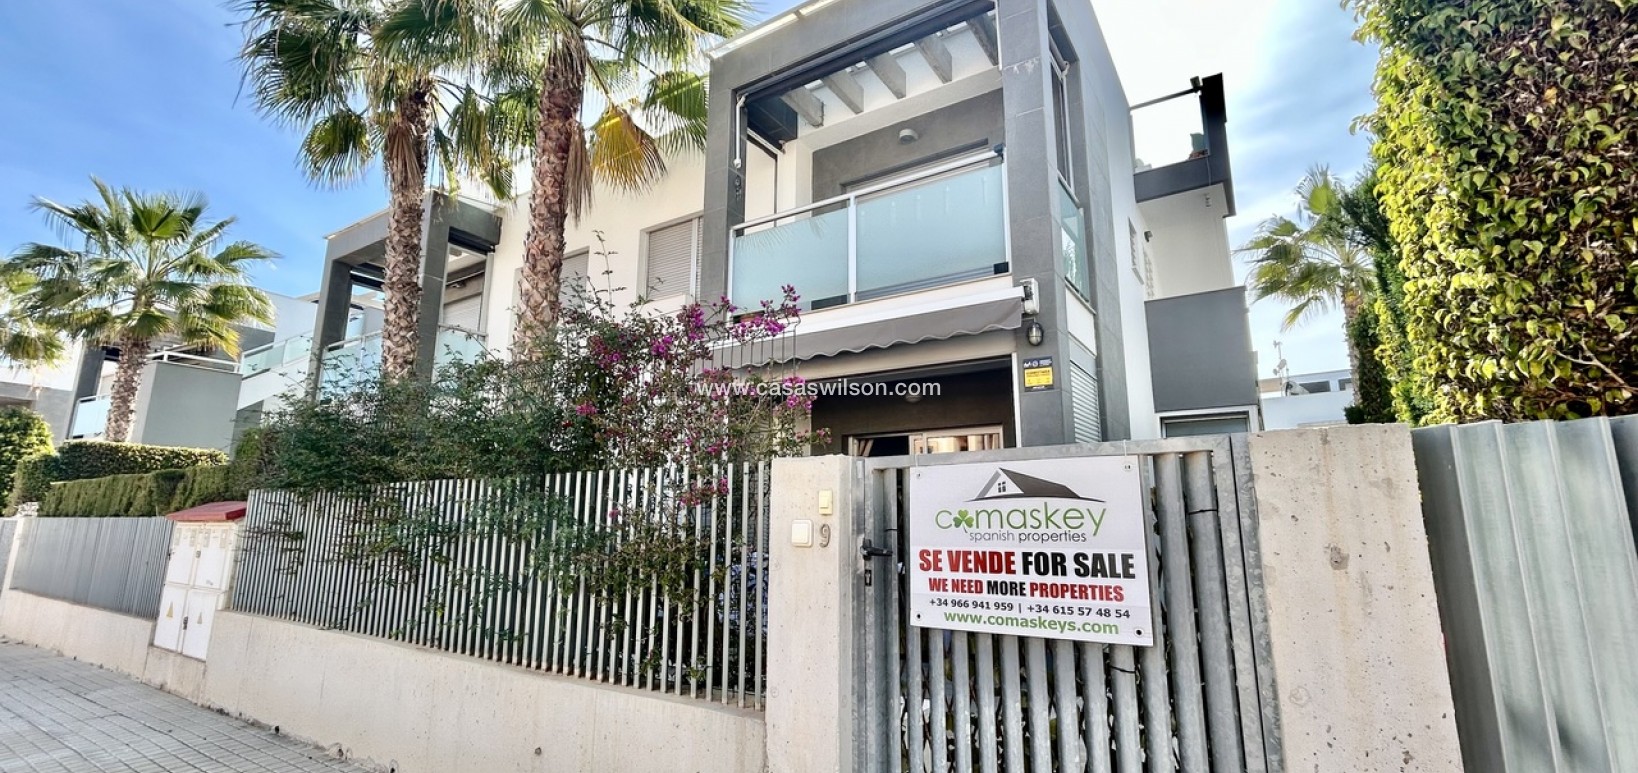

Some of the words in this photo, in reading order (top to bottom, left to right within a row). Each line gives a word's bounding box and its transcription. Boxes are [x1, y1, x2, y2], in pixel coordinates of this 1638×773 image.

[935, 502, 1106, 536] comaskey
[819, 523, 831, 548] 9
[970, 530, 1015, 542] spanish
[1019, 531, 1086, 543] properties
[919, 549, 943, 571] SE
[947, 550, 1016, 574] VENDE
[1022, 552, 1066, 576] FOR
[1074, 553, 1135, 579] SALE
[929, 578, 948, 592] WE
[952, 579, 983, 593] NEED
[987, 581, 1026, 596] MORE
[1030, 582, 1124, 601] PROPERTIES
[930, 599, 948, 608] +34
[951, 599, 969, 609] 966
[972, 600, 990, 609] 941
[994, 601, 1013, 611] 959
[1028, 604, 1049, 614] +34
[1053, 605, 1074, 615] 615
[1078, 606, 1091, 616] 57
[1096, 608, 1111, 617] 48
[1115, 609, 1130, 618] 54
[944, 612, 1118, 634] www.comaskeys.com
